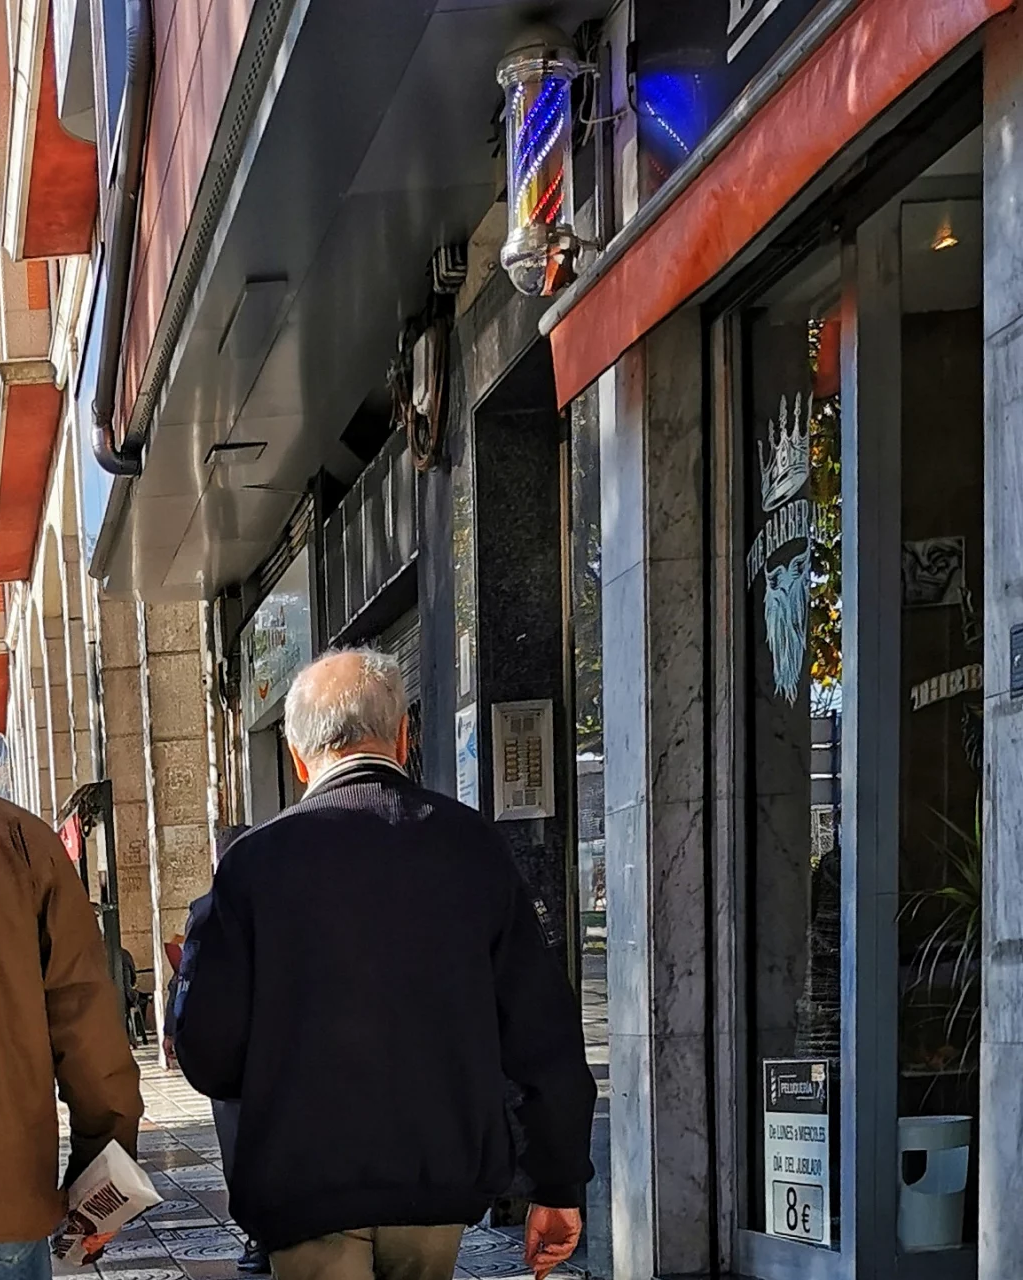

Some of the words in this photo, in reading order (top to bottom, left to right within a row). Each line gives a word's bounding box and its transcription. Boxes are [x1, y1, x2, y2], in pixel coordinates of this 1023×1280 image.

[746, 529, 765, 590] THE
[765, 499, 809, 559] BARBER
[777, 1125, 794, 1141] LUNES
[784, 1156, 795, 1173] DEL
[82, 1181, 129, 1221] TAHONA
